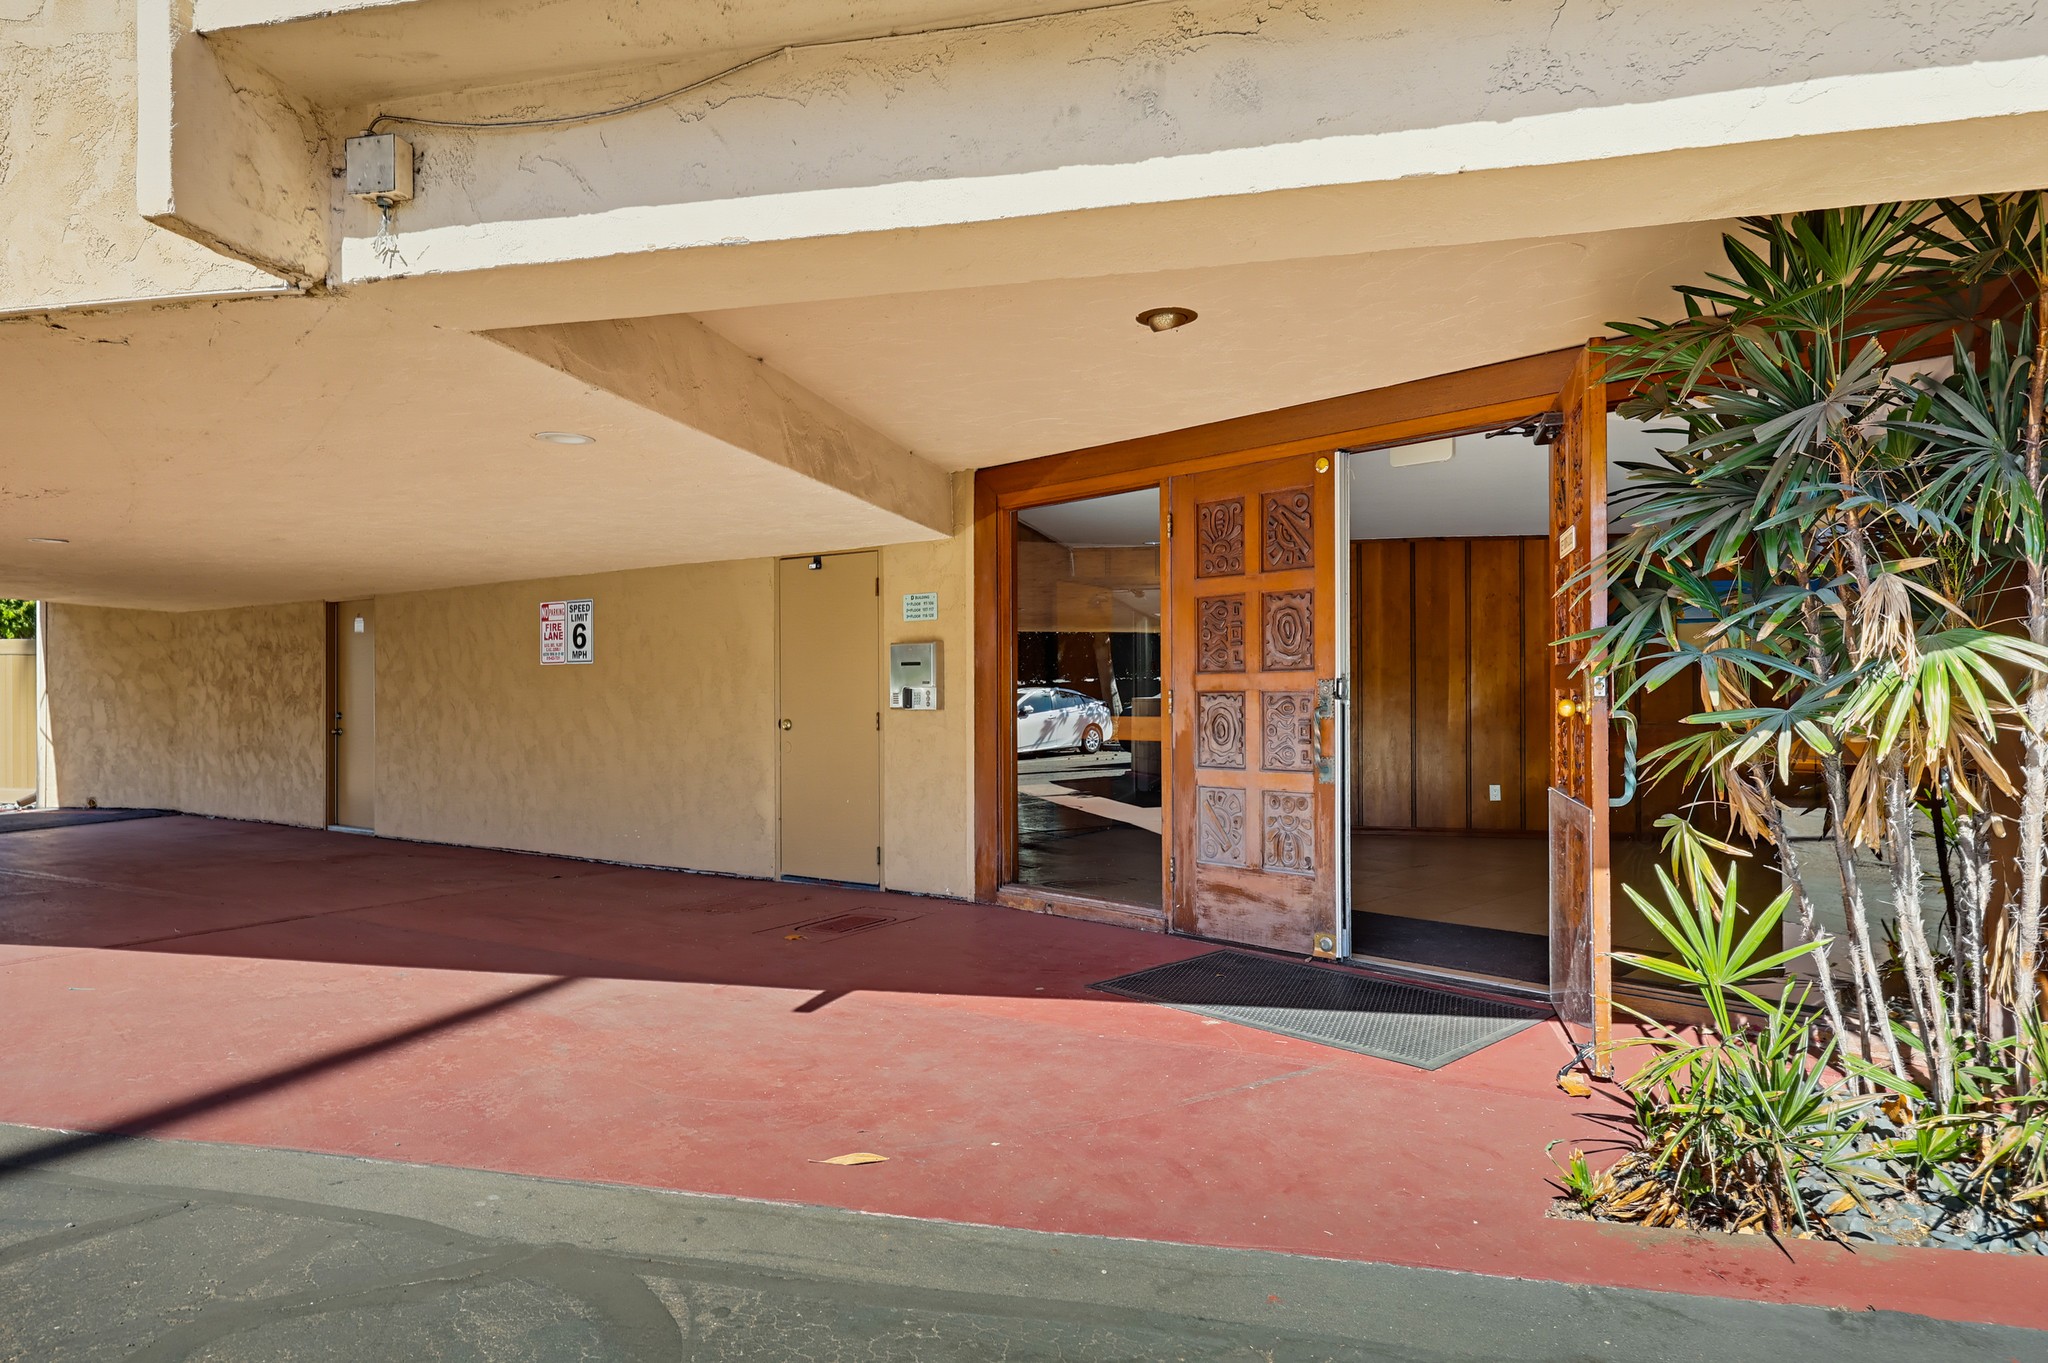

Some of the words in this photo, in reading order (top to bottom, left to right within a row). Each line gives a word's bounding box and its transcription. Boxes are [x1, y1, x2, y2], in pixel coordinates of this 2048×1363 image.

[541, 606, 549, 618] NO
[549, 608, 565, 616] PARKING
[569, 604, 590, 613] SPEED
[571, 613, 588, 622] LIMIT
[545, 623, 562, 631] FIRE
[544, 632, 563, 640] LANE
[572, 623, 587, 650] 6
[572, 651, 587, 659] MPH
